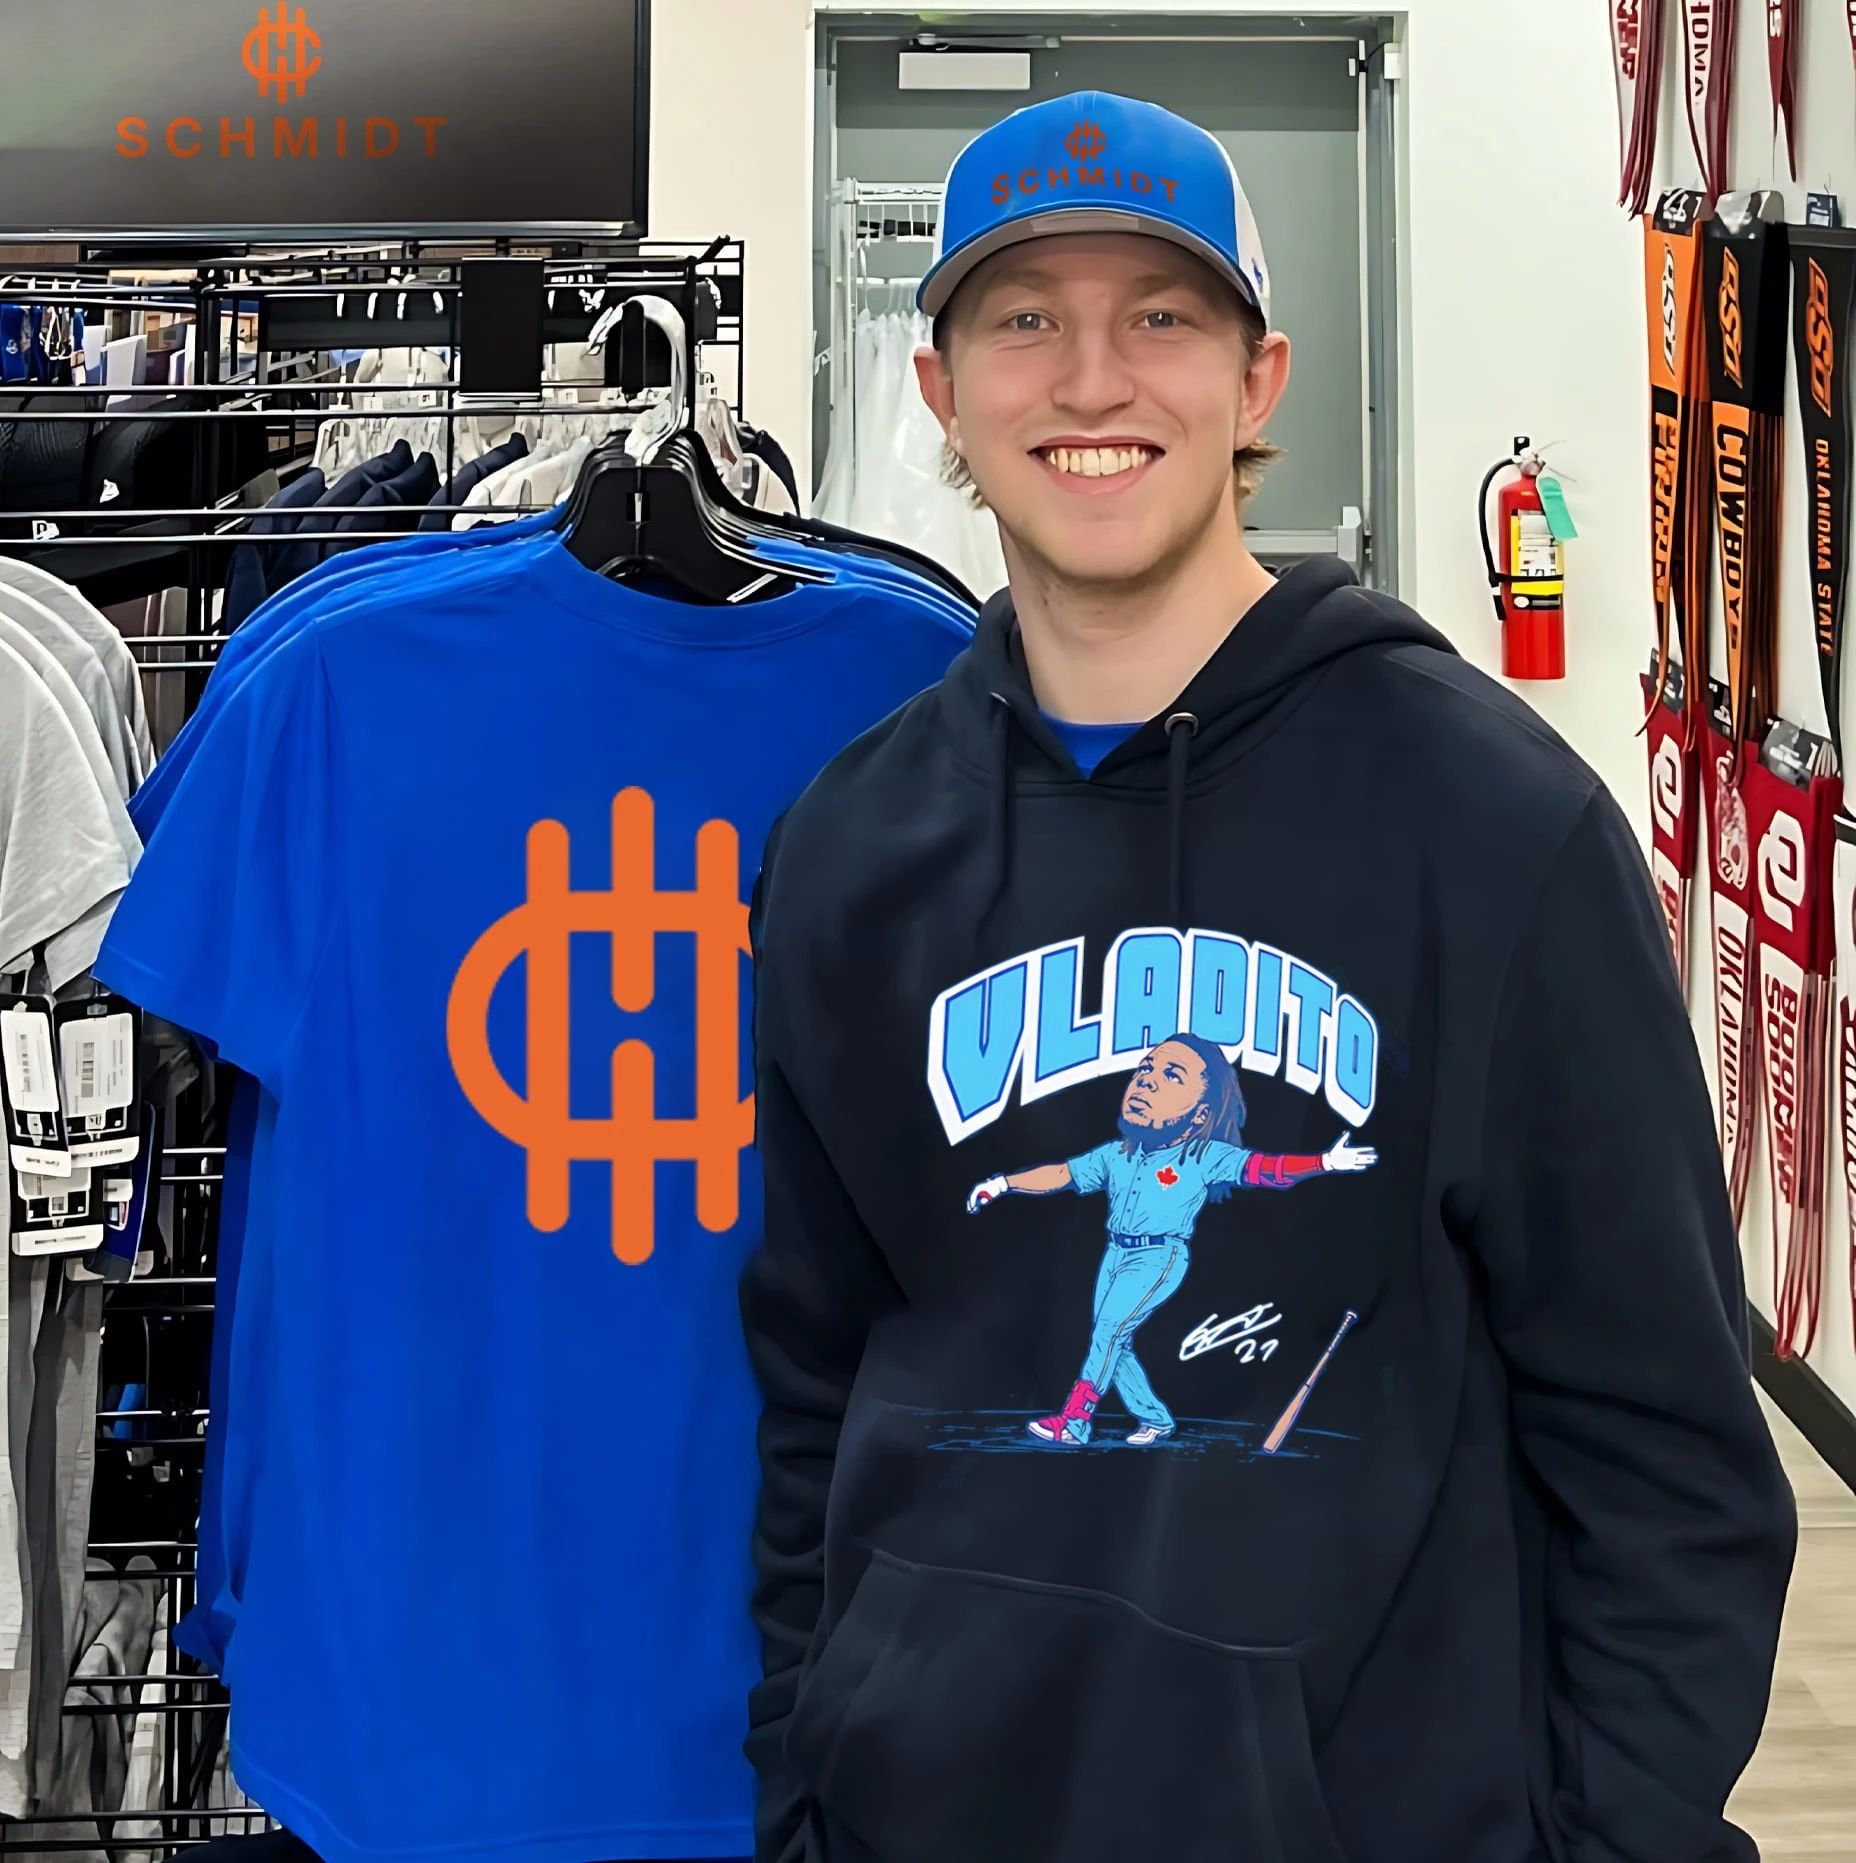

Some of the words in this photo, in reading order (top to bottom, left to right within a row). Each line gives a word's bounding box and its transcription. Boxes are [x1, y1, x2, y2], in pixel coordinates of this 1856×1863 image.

[116, 117, 447, 158] SCHMIDT
[992, 167, 1180, 204] SCHMIDT
[1816, 438, 1832, 570] OKLAHOMA
[928, 926, 1379, 1147] VLADITO
[1718, 926, 1744, 1143] OKLAHOMA
